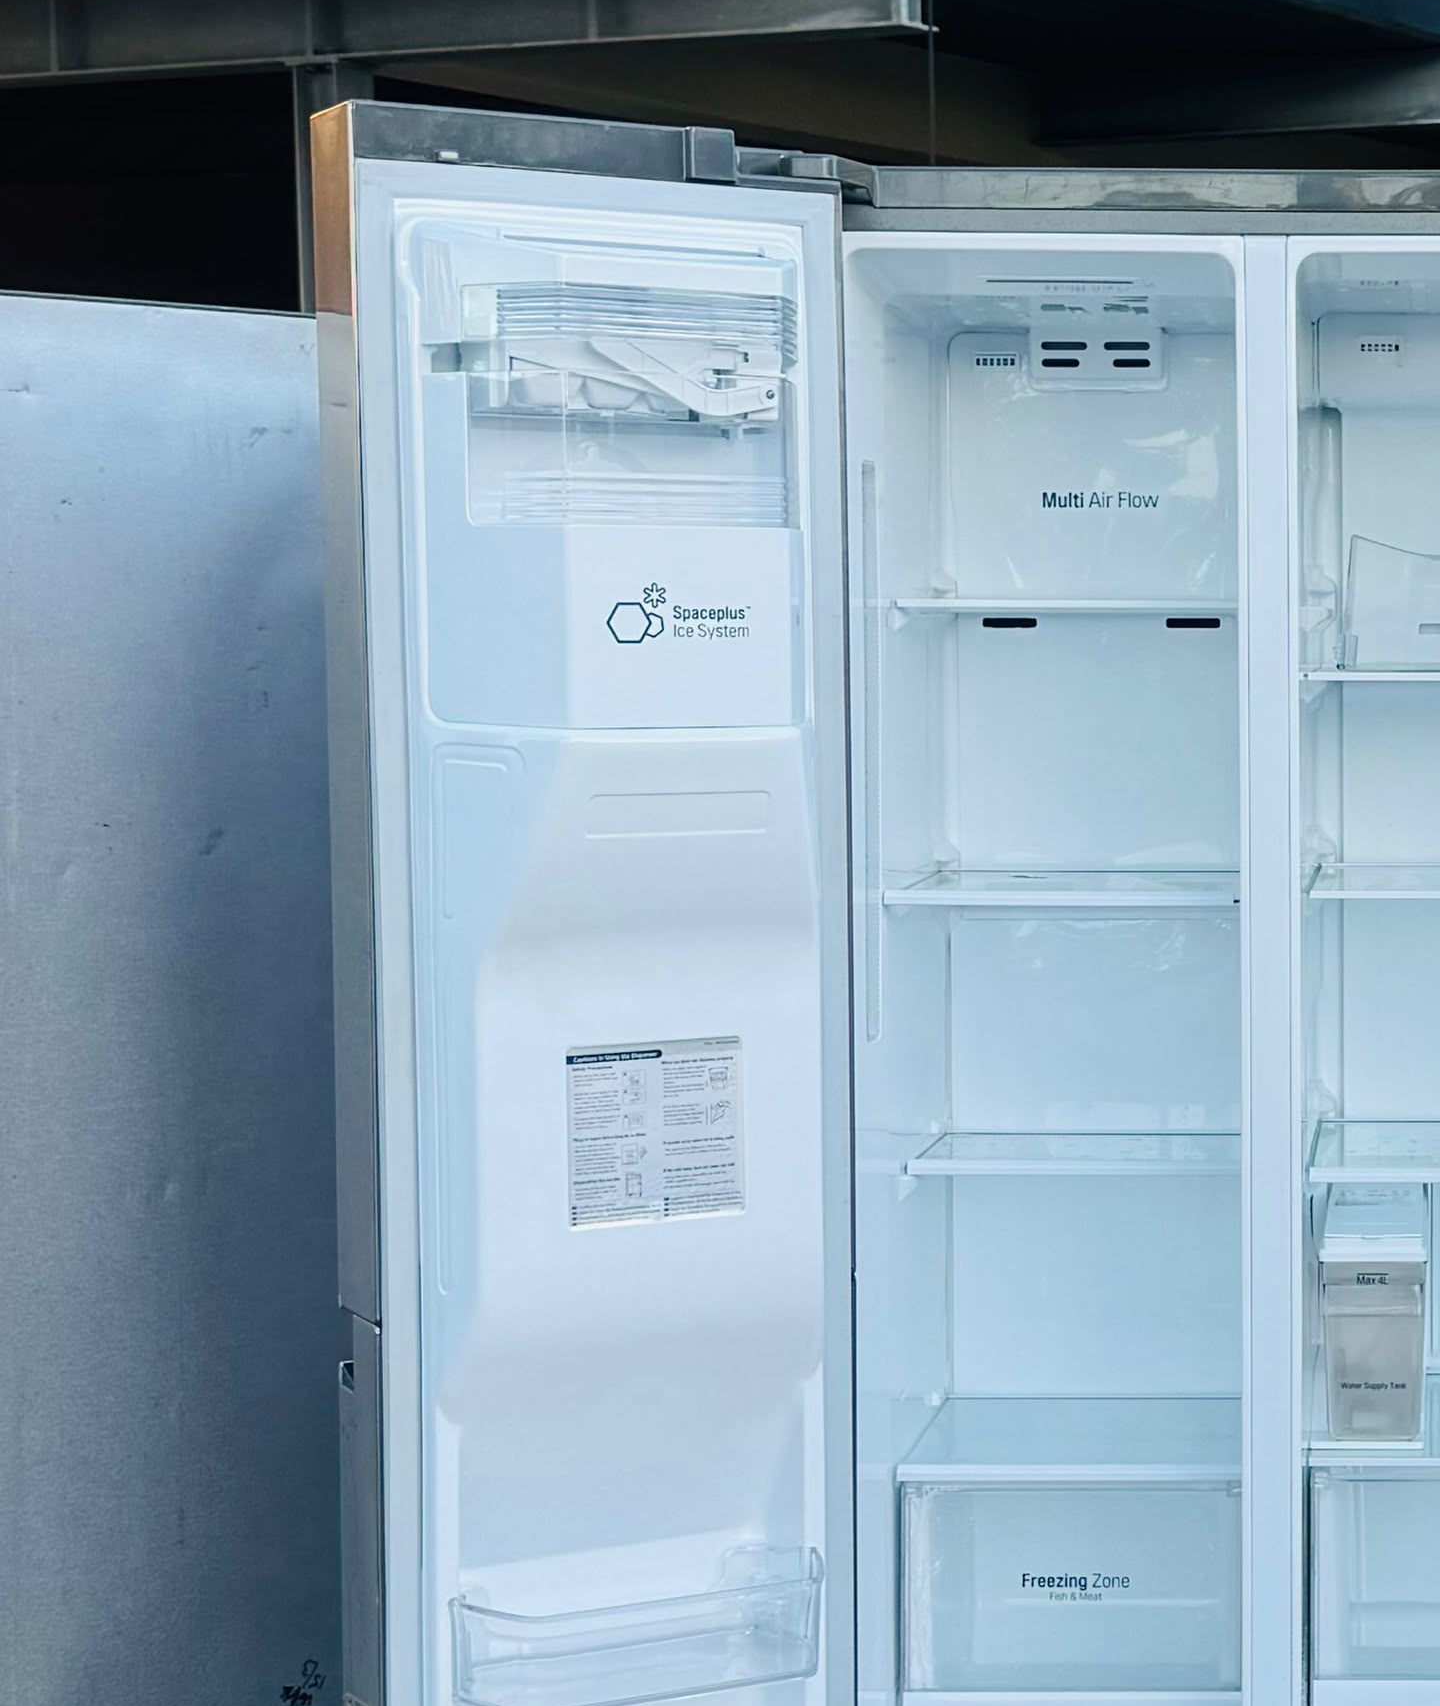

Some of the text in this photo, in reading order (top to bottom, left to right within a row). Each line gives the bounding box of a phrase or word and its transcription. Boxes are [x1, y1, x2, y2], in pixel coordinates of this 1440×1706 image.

[1042, 491, 1159, 509] Multi Air Flow
[673, 623, 750, 640] Ice System
[1356, 1275, 1389, 1286] Max 4L
[1340, 1380, 1363, 1391] Water
[1363, 1380, 1389, 1392] Supply
[1021, 1572, 1131, 1592] Freezing Zone
[1078, 1592, 1103, 1602] Meat
